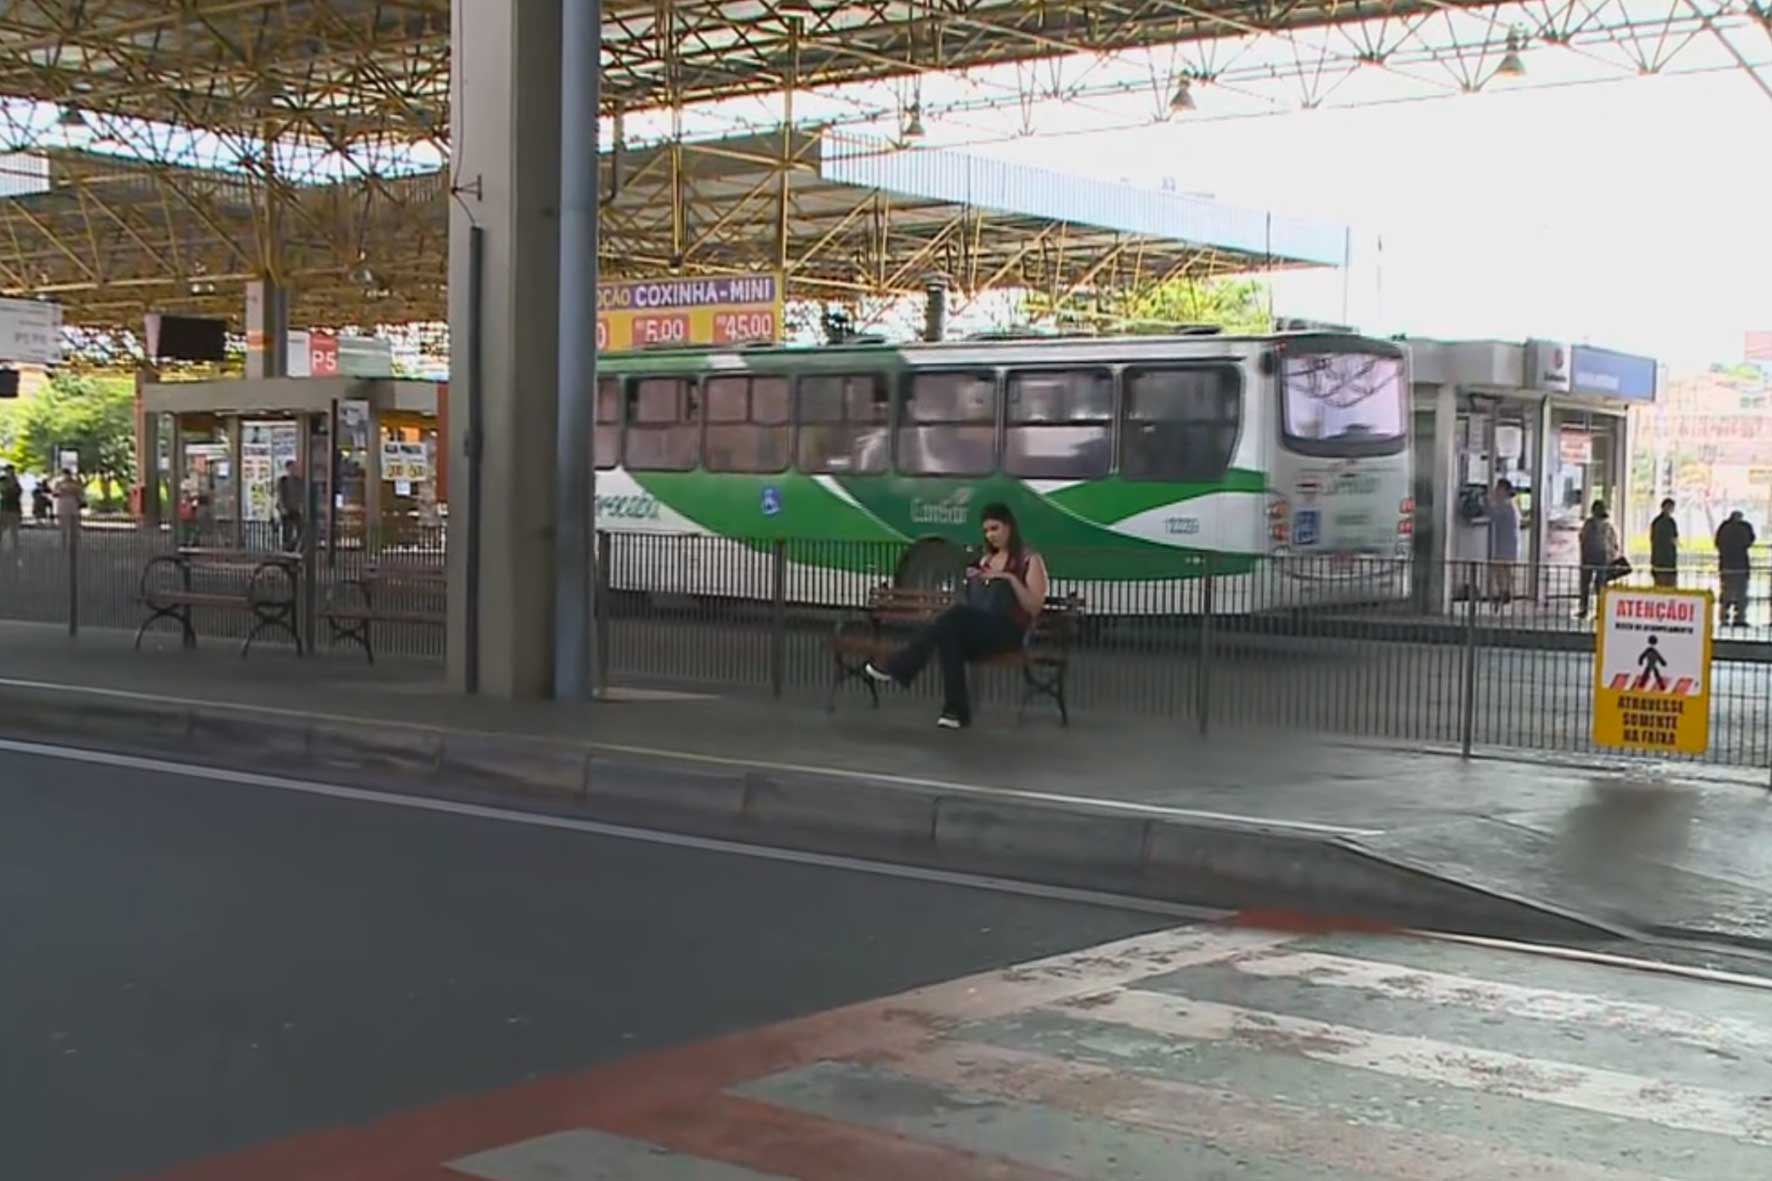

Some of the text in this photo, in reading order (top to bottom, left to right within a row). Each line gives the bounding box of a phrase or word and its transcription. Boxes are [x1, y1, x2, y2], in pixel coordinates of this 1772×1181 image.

[311, 350, 337, 371] P5
[1616, 599, 1695, 622] ATENÇÃO!
[1617, 695, 1684, 715] ATRAVESSE
[1623, 711, 1677, 730] SOMENTE
[1624, 729, 1676, 746] NA FAIXA
